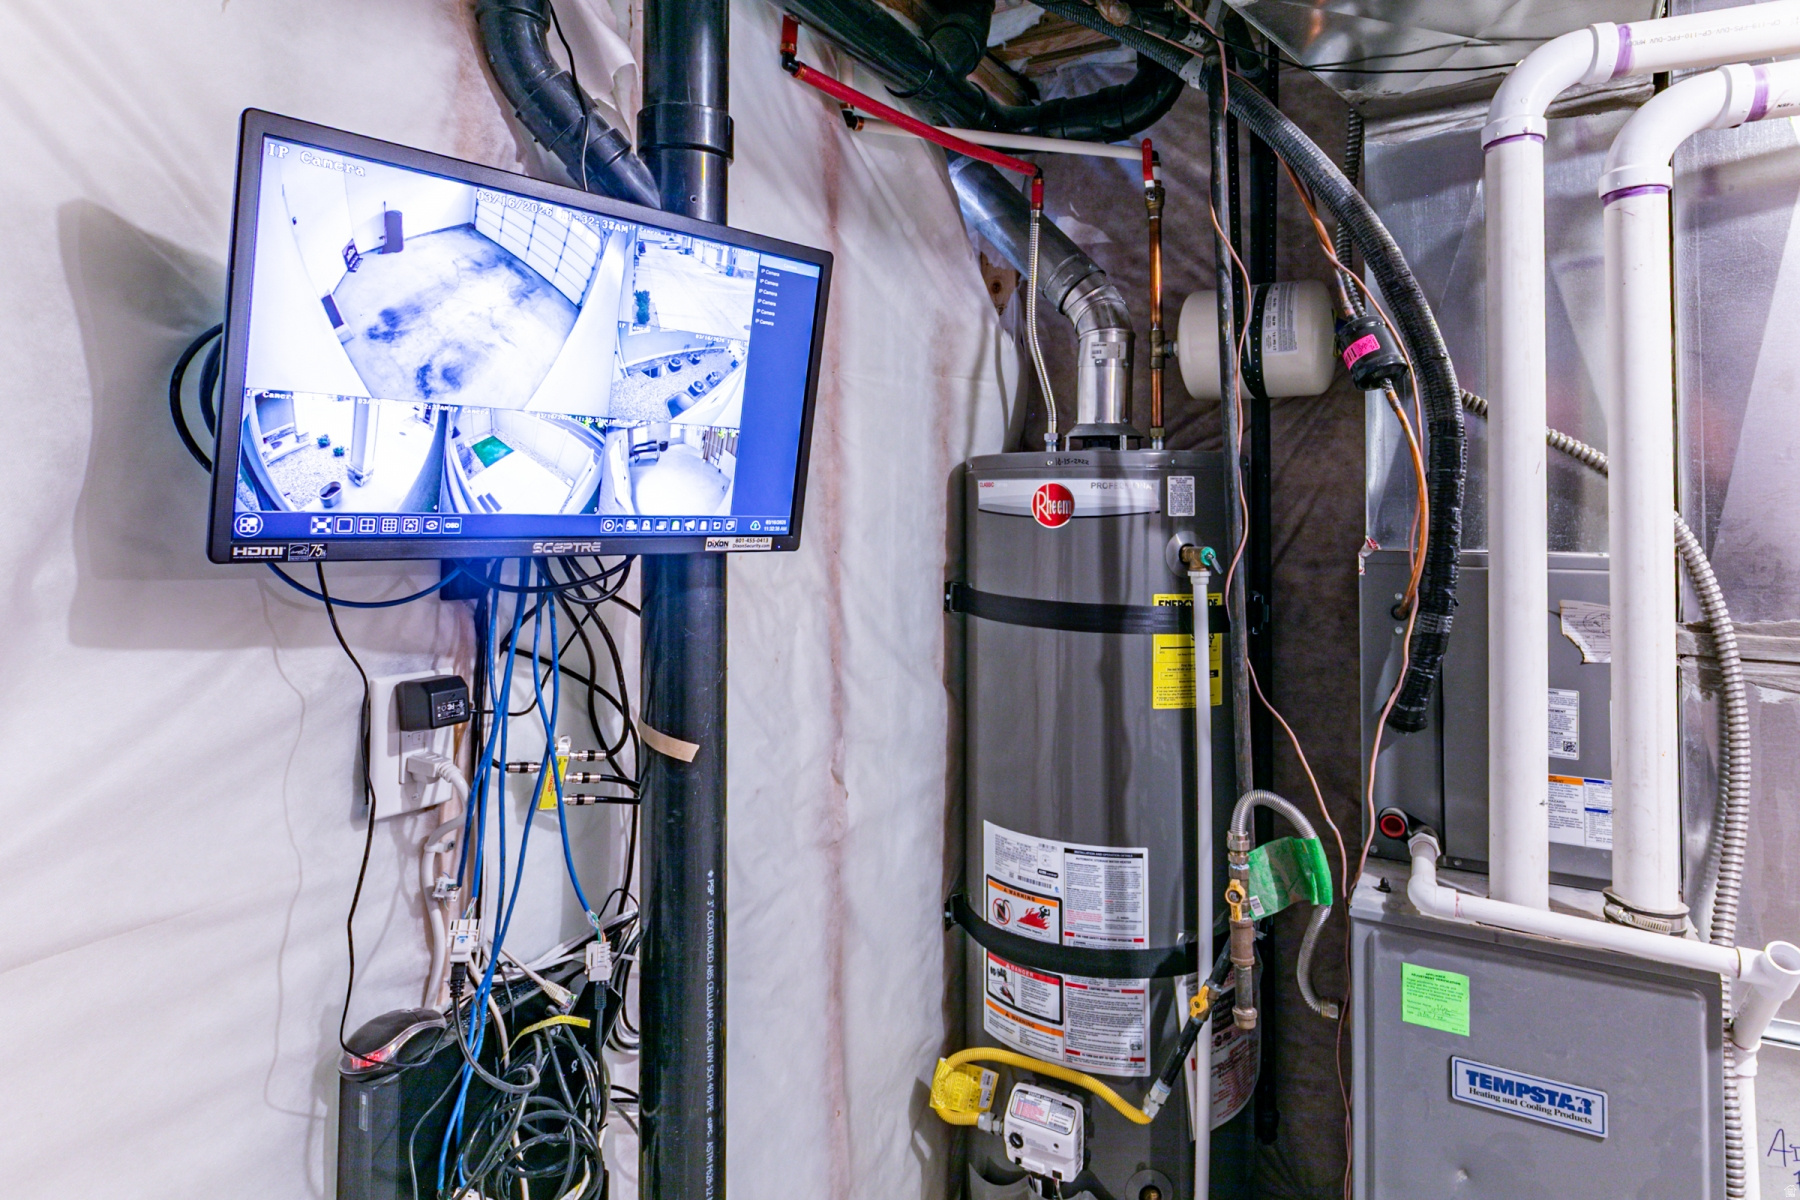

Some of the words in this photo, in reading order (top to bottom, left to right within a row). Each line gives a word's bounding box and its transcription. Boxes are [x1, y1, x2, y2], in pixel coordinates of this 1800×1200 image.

[268, 143, 289, 159] IP
[300, 151, 366, 177] Camera
[476, 190, 553, 217] 03/16/2026
[766, 269, 780, 277] Camera
[764, 279, 779, 287] Camera
[763, 289, 778, 297] Camera
[762, 299, 776, 307] Camera
[761, 309, 775, 317] Camera
[1036, 484, 1072, 521] Rheem
[233, 546, 284, 556] HDMI
[532, 541, 602, 554] SCEPTRE
[1008, 889, 1036, 902] WARNING
[1010, 965, 1034, 978] DANGER
[1011, 1014, 1036, 1029] WARNING
[707, 1082, 714, 1093] 40
[1466, 1069, 1593, 1116] TEMPSTAR
[1469, 1087, 1501, 1103] Heating
[1502, 1097, 1518, 1106] and
[1520, 1100, 1553, 1116] Cooling
[1554, 1108, 1593, 1125] Products
